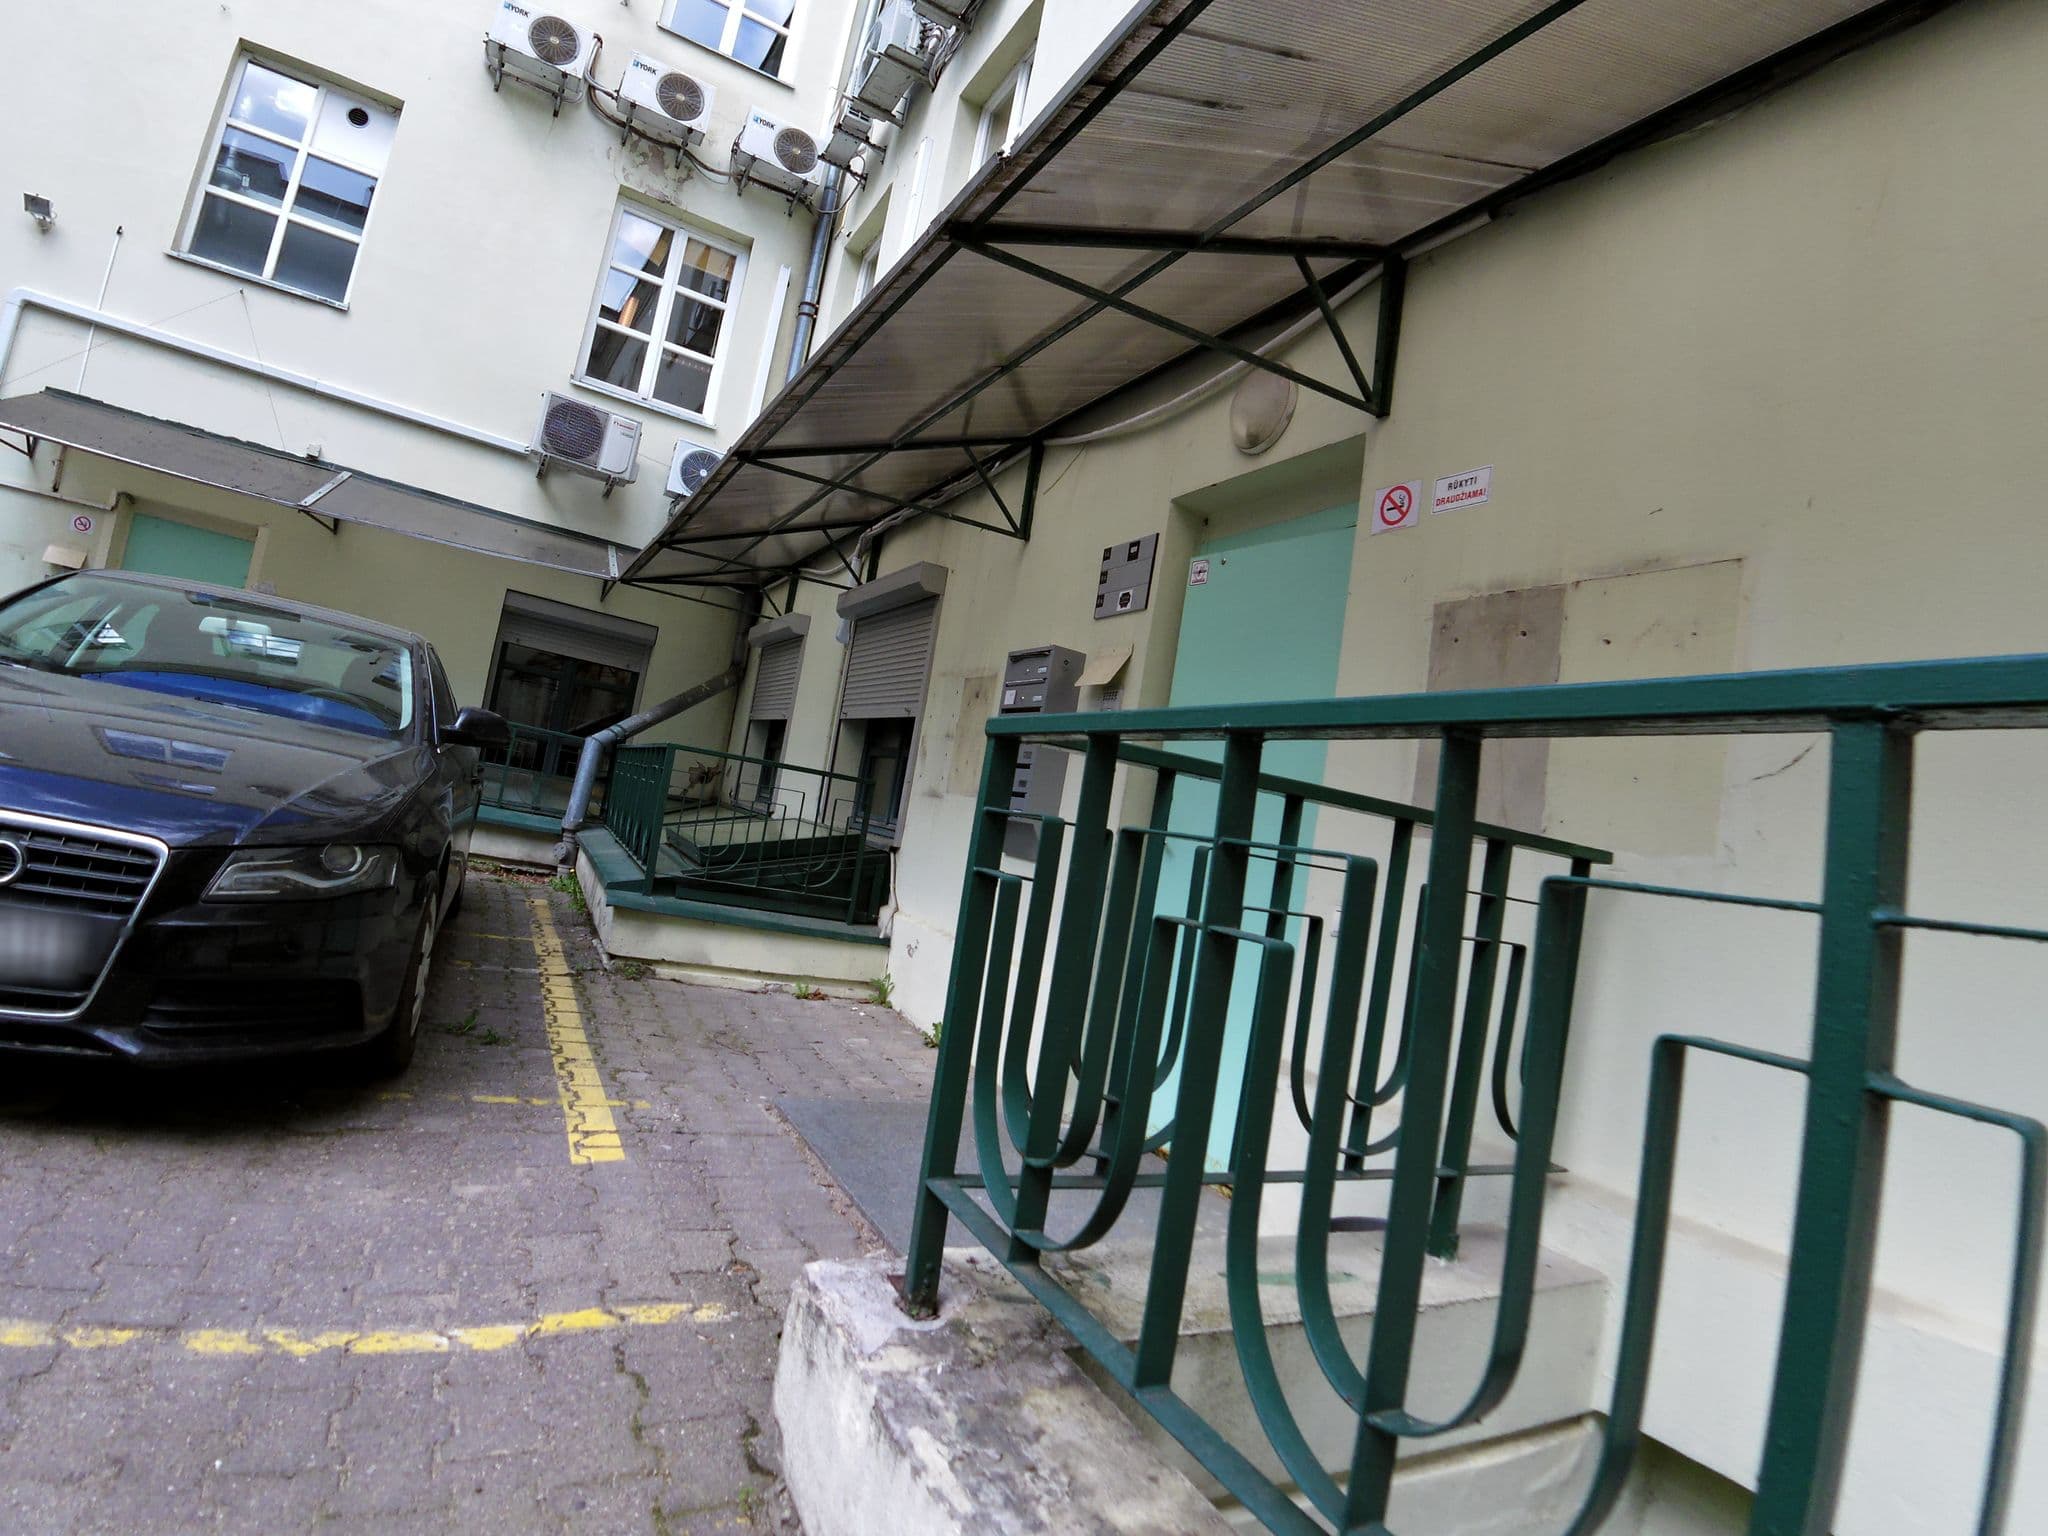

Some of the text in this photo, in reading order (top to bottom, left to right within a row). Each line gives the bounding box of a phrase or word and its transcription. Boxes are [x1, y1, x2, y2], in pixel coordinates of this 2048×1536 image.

[511, 4, 530, 18] YORK
[639, 62, 657, 75] YORK
[759, 117, 776, 130] YORK
[1447, 476, 1478, 491] RŪKYTI
[1435, 487, 1487, 506] DRAUDŽIAMA!
